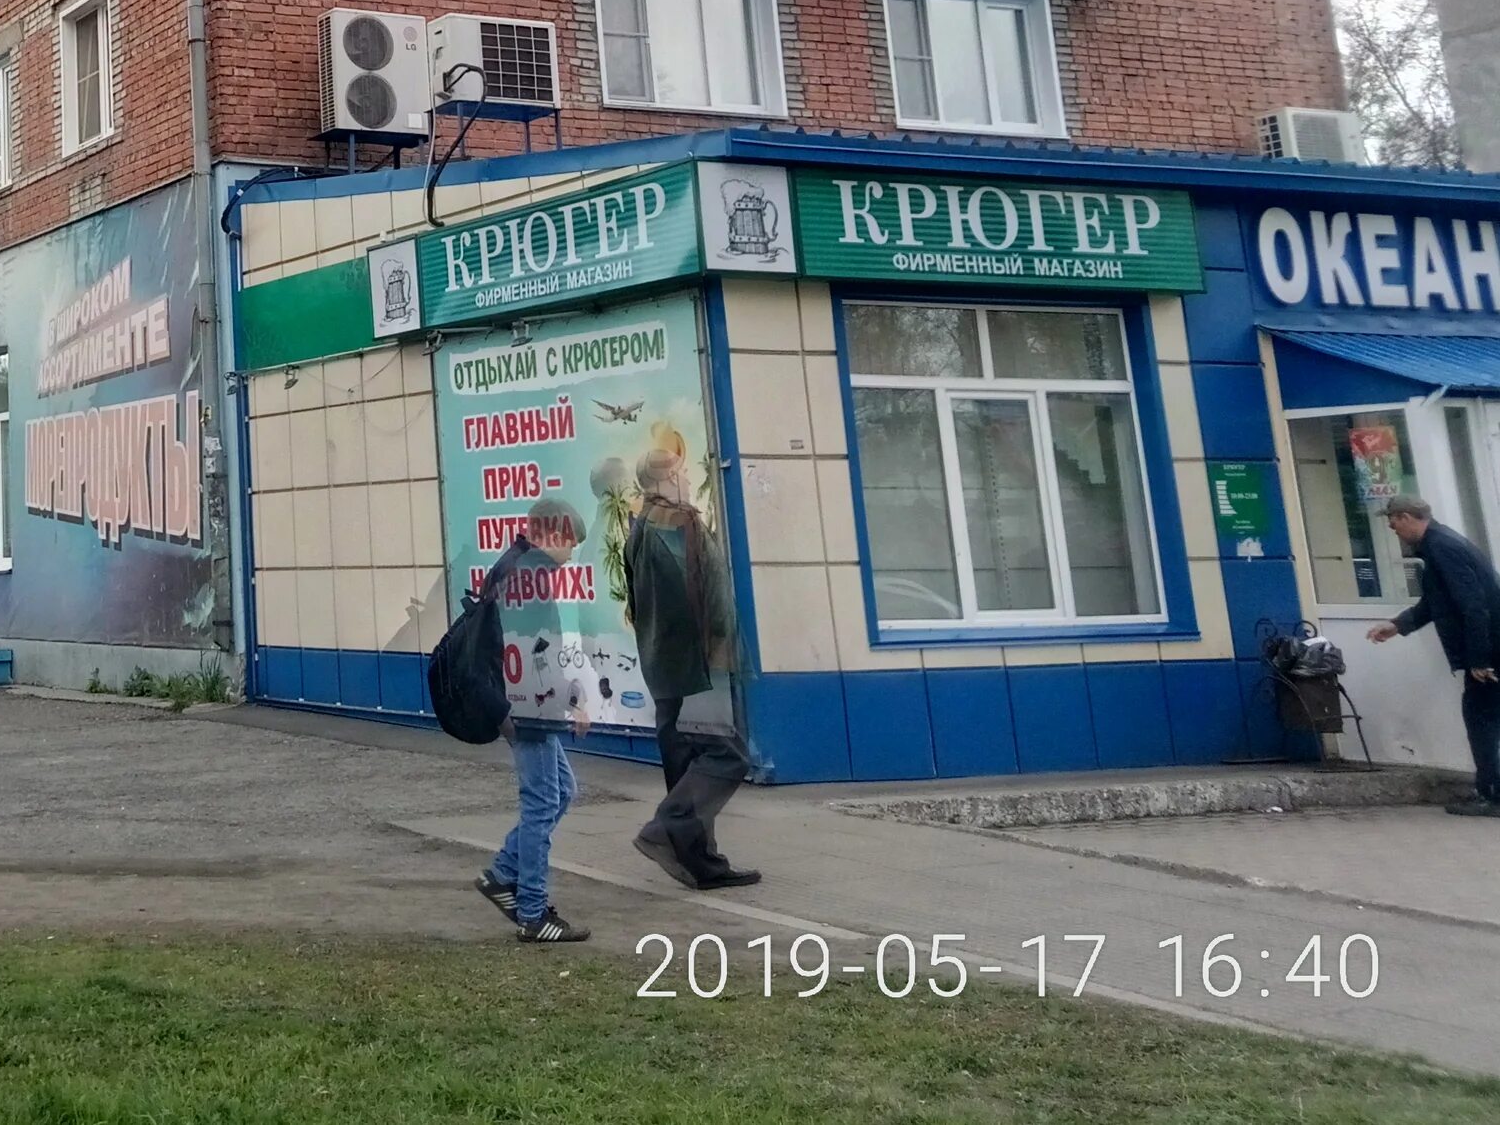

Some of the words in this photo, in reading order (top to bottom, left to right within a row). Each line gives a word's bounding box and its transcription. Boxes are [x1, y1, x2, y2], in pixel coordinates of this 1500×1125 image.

[441, 182, 666, 292] КРЮГЕР
[832, 179, 1160, 255] КРЮГЕР
[475, 273, 560, 307] ФИРМЕННЫЙ
[566, 259, 633, 289] МАГАЗИН
[893, 252, 1024, 276] ФИРМЕННЫЙ
[1034, 257, 1123, 279] МАГАЗИН
[1258, 206, 1500, 311] ОКЕАН
[56, 255, 132, 342] ШИРОКОМ
[38, 293, 171, 397] АССОРТИМЕНТЕ
[454, 345, 537, 393] ОТДЫХАЙ
[546, 347, 558, 377] С
[562, 328, 665, 375] КРЮГЕРОМ!
[464, 396, 575, 450] ГЛАВНЫЙ
[25, 390, 201, 544] МОРЕПРОДУКТЫ
[483, 463, 541, 500] ПРИЗ
[505, 566, 595, 608] ДВОИХ!
